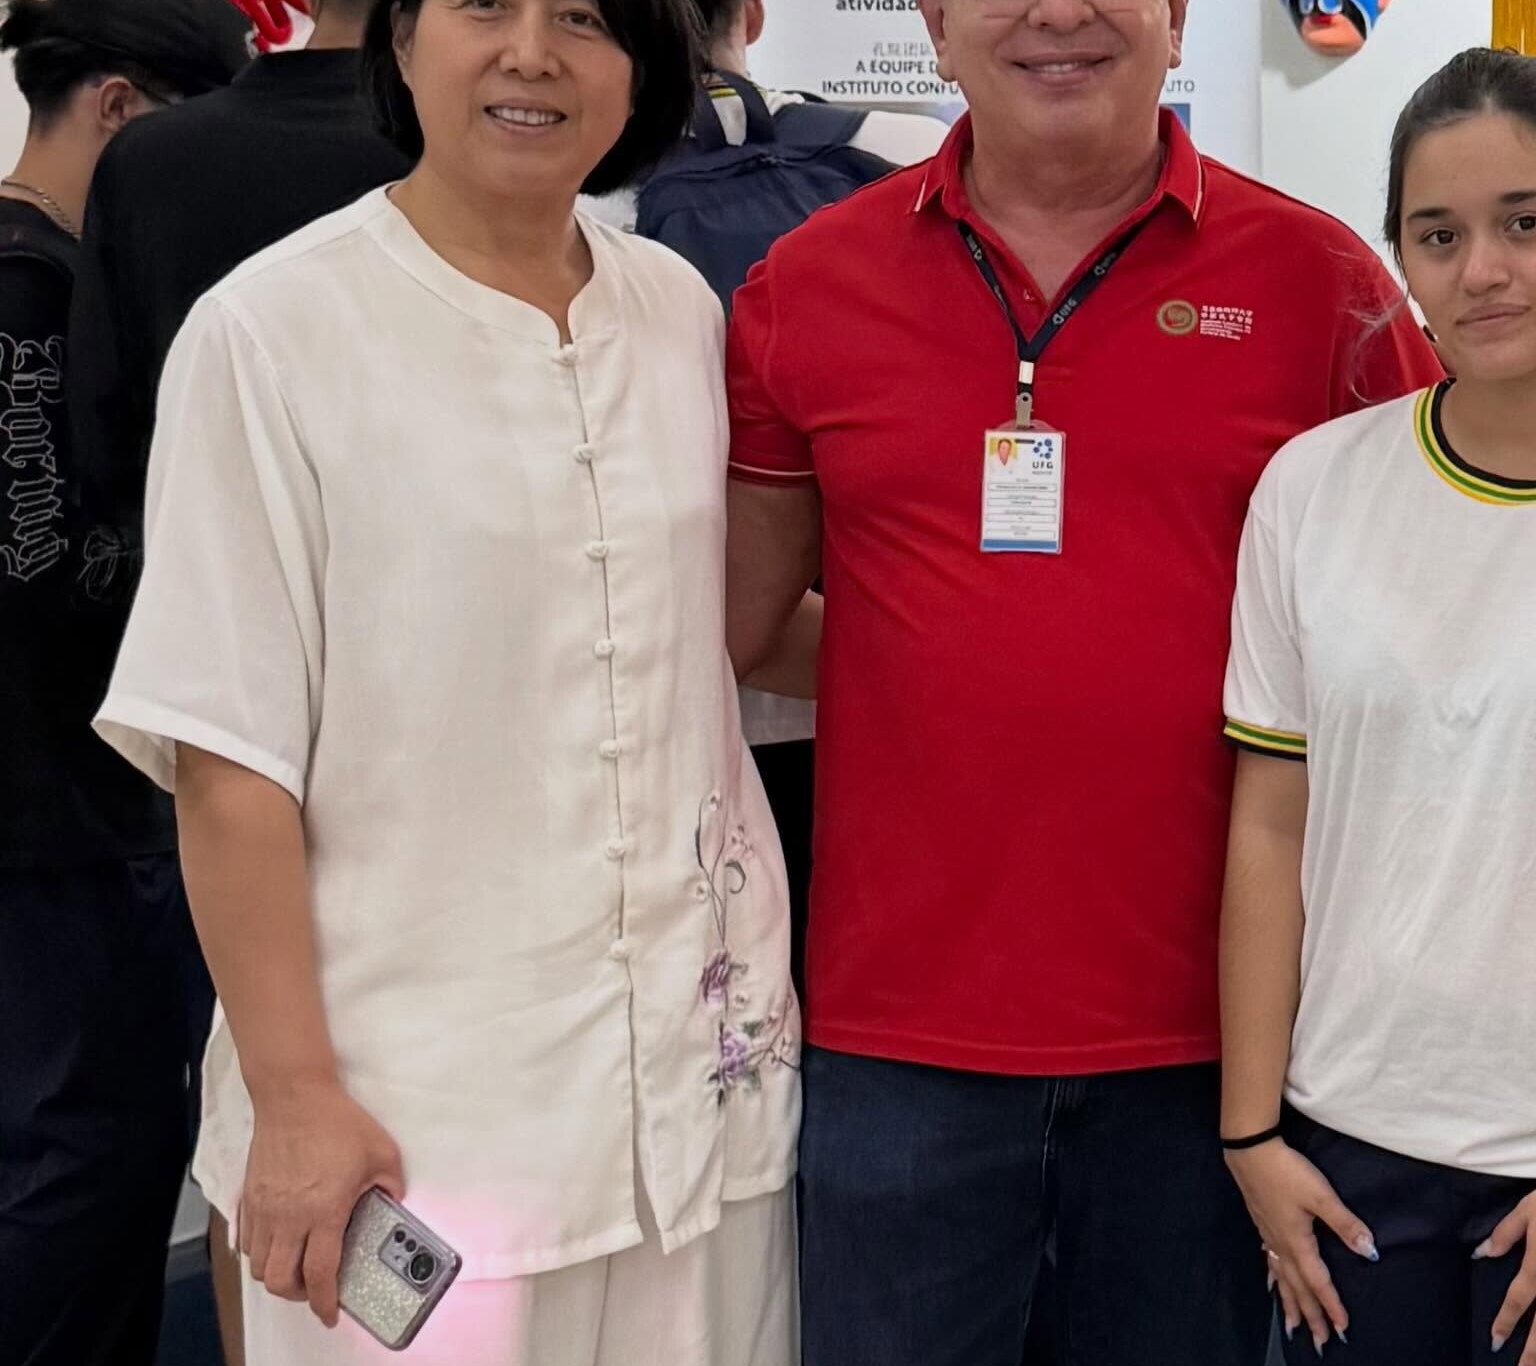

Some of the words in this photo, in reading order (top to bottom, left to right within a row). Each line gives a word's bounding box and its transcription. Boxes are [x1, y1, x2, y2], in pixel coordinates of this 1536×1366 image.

[856, 60, 866, 73] A
[870, 60, 925, 75] EQUIPE
[822, 80, 903, 95] INSTITUTO
